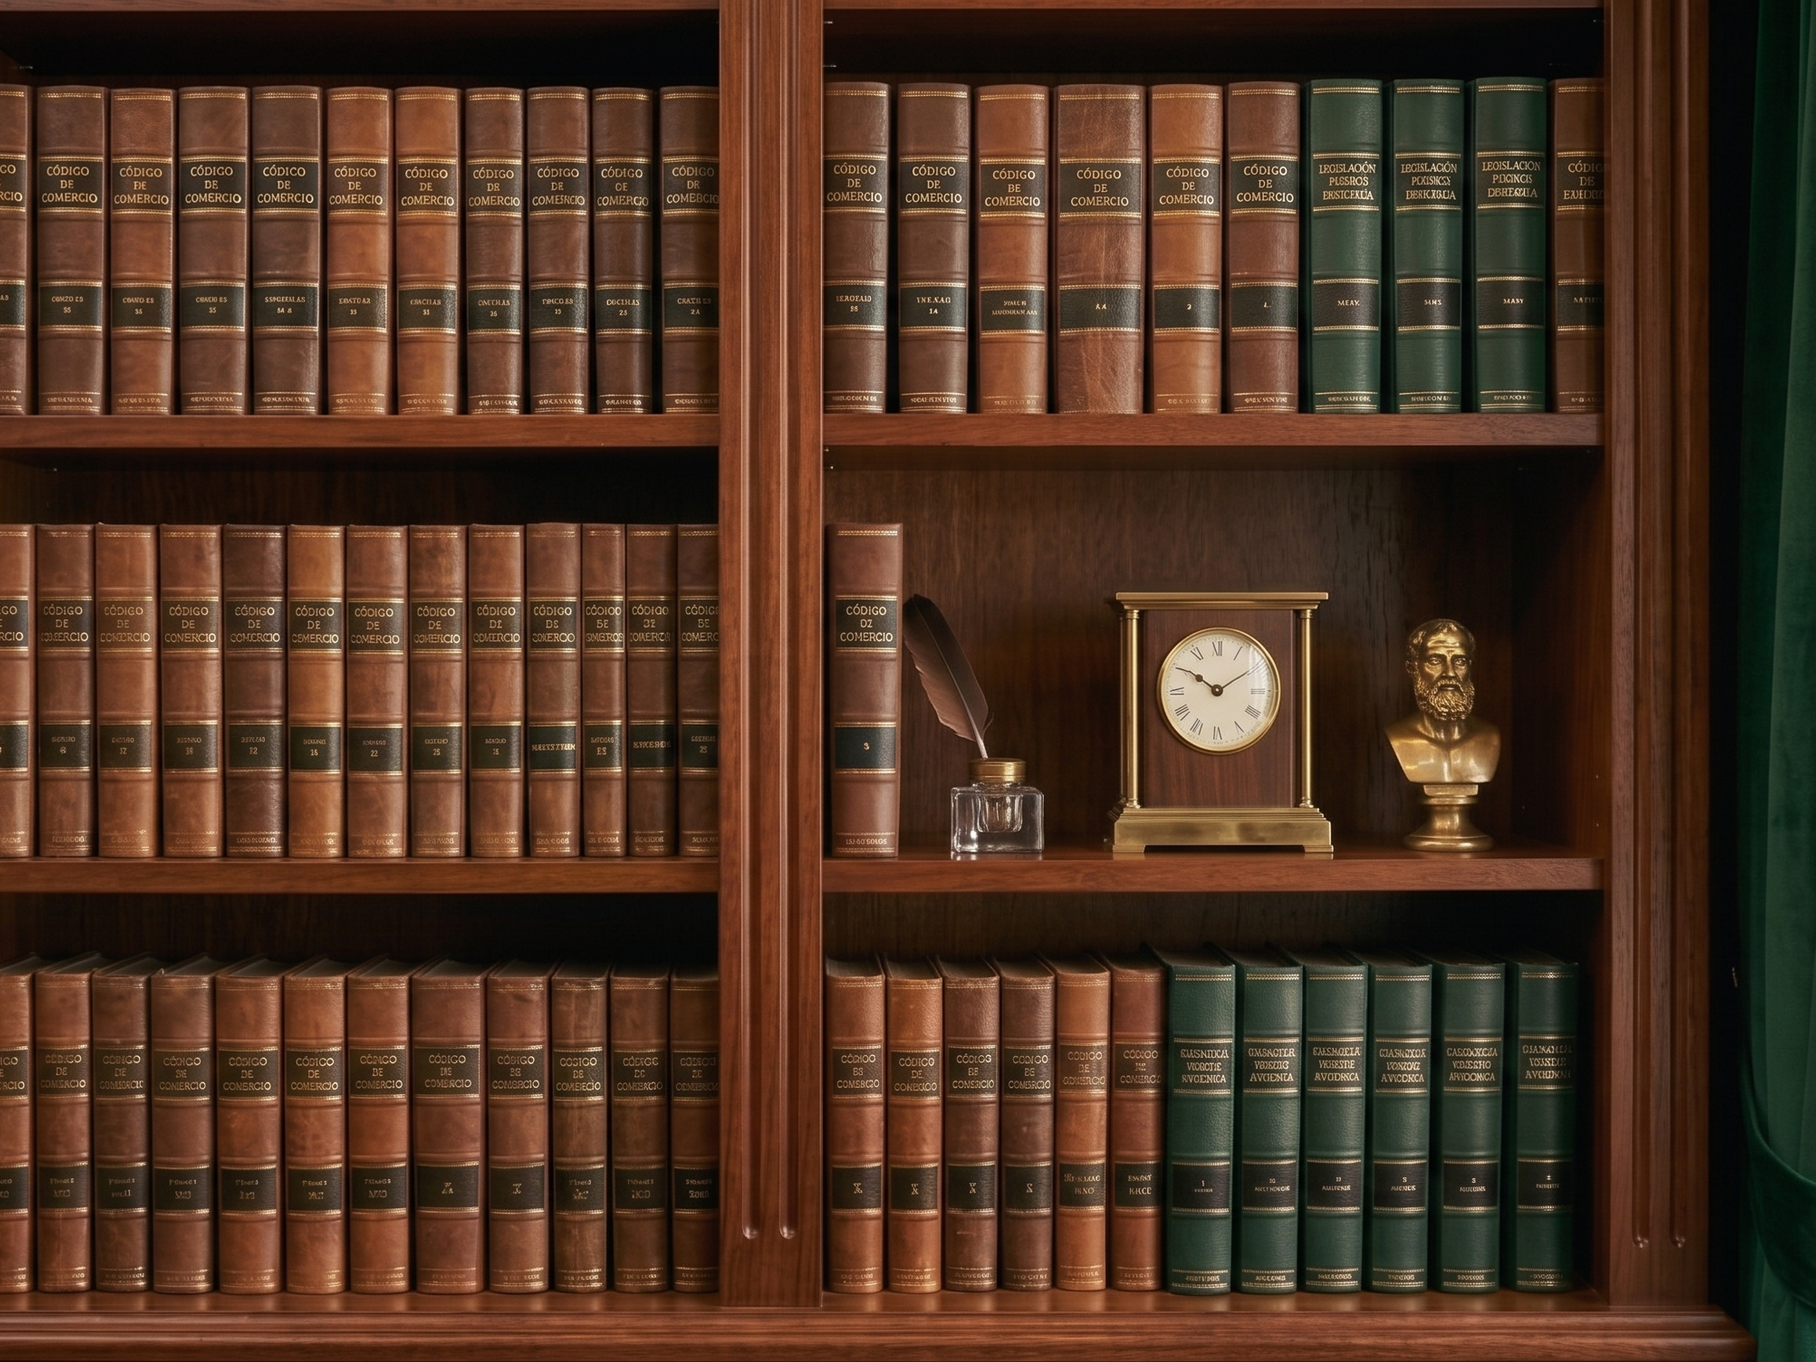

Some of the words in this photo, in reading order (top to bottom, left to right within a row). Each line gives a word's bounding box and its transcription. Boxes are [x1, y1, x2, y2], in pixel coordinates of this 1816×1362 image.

[46, 165, 89, 176] CÓDIGO
[120, 166, 162, 177] CÓDIGO
[190, 165, 233, 176] CÓDIGO
[334, 166, 376, 178] CÓDIGO
[405, 166, 448, 178] CÓDIGO
[472, 167, 514, 179] CÓDIGO
[537, 166, 579, 178] CÓDIGO
[601, 166, 643, 178] CÓDIGO
[912, 164, 956, 176] CÓDIGO
[992, 168, 1036, 179] CÓDIGO
[1076, 168, 1121, 179] CÓDIGO
[1166, 166, 1209, 178] CÓDIGO
[1243, 164, 1288, 176] CÓDIGO
[60, 180, 74, 189] DE
[205, 180, 218, 189] DE
[277, 181, 291, 189] DE
[348, 182, 362, 190] DE
[419, 182, 433, 191] DE
[847, 179, 861, 187] DE
[1182, 182, 1195, 191] DE
[1258, 180, 1272, 188] DE
[1093, 184, 1108, 193] DE
[42, 193, 98, 203] COMERCIO
[114, 194, 169, 204] COMERCIO
[185, 193, 241, 203] COMERCIO
[257, 194, 314, 203] COMERCIO
[329, 195, 383, 205] COMERCIO
[401, 196, 454, 206] COMERCIO
[468, 196, 520, 206] COMERCIO
[827, 192, 882, 202] COMERCIO
[905, 193, 962, 203] COMERCIO
[984, 196, 1040, 206] COMERCIO
[1071, 197, 1129, 206] COMERCIO
[1159, 195, 1214, 205] COMERCIO
[1236, 193, 1294, 203] COMERCIO
[169, 604, 208, 616] CÓDIGO
[295, 605, 334, 617] CÓDIGO
[354, 606, 394, 617] CÓDIGO
[846, 603, 887, 616] CÓDIGO
[55, 619, 69, 628] DE
[181, 620, 195, 629] DE
[840, 632, 893, 642] COMERCIO
[55, 1067, 67, 1076] DE
